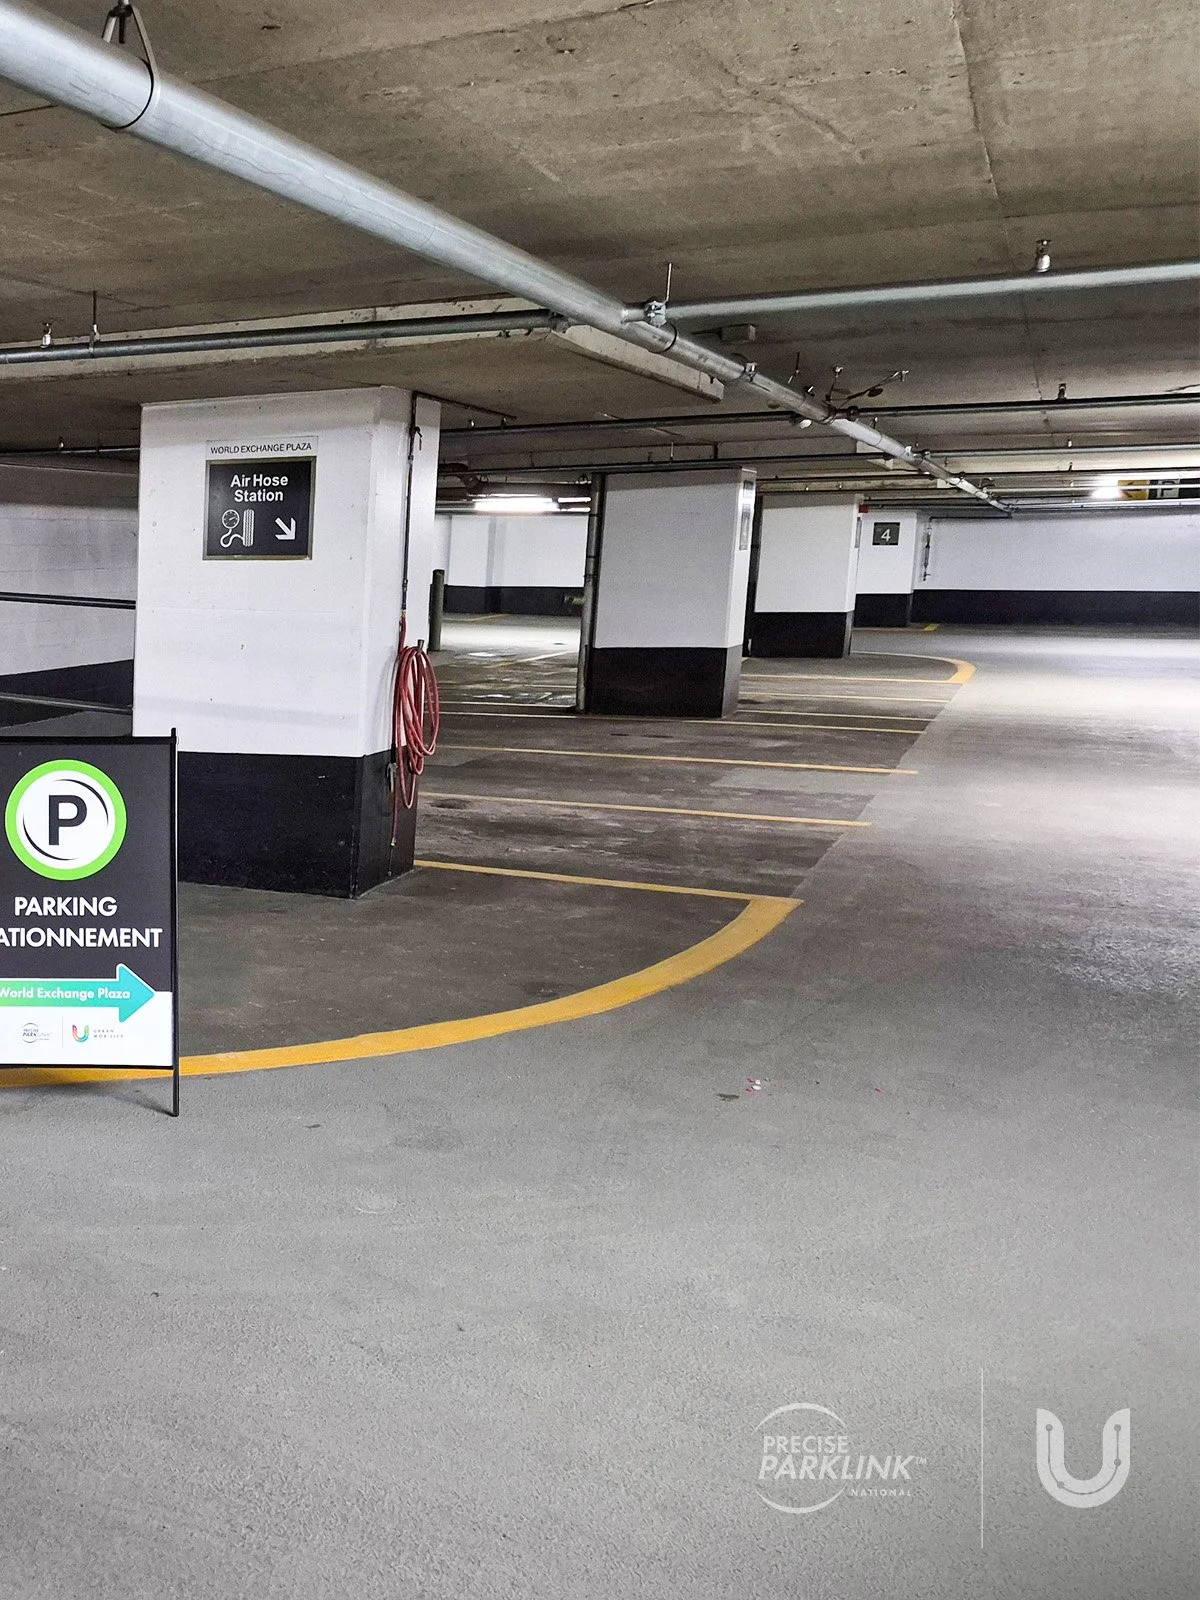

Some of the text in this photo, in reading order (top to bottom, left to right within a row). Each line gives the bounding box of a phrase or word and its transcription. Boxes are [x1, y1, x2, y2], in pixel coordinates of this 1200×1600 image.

[210, 443, 312, 454] WORLD EXCHANGE PLAZA
[230, 474, 289, 488] Air Hose
[234, 489, 284, 502] Station
[880, 528, 891, 542] 4
[48, 794, 88, 846] P
[14, 896, 118, 917] PARKING
[37, 987, 95, 1001] Exchange
[97, 987, 131, 999] Plaza
